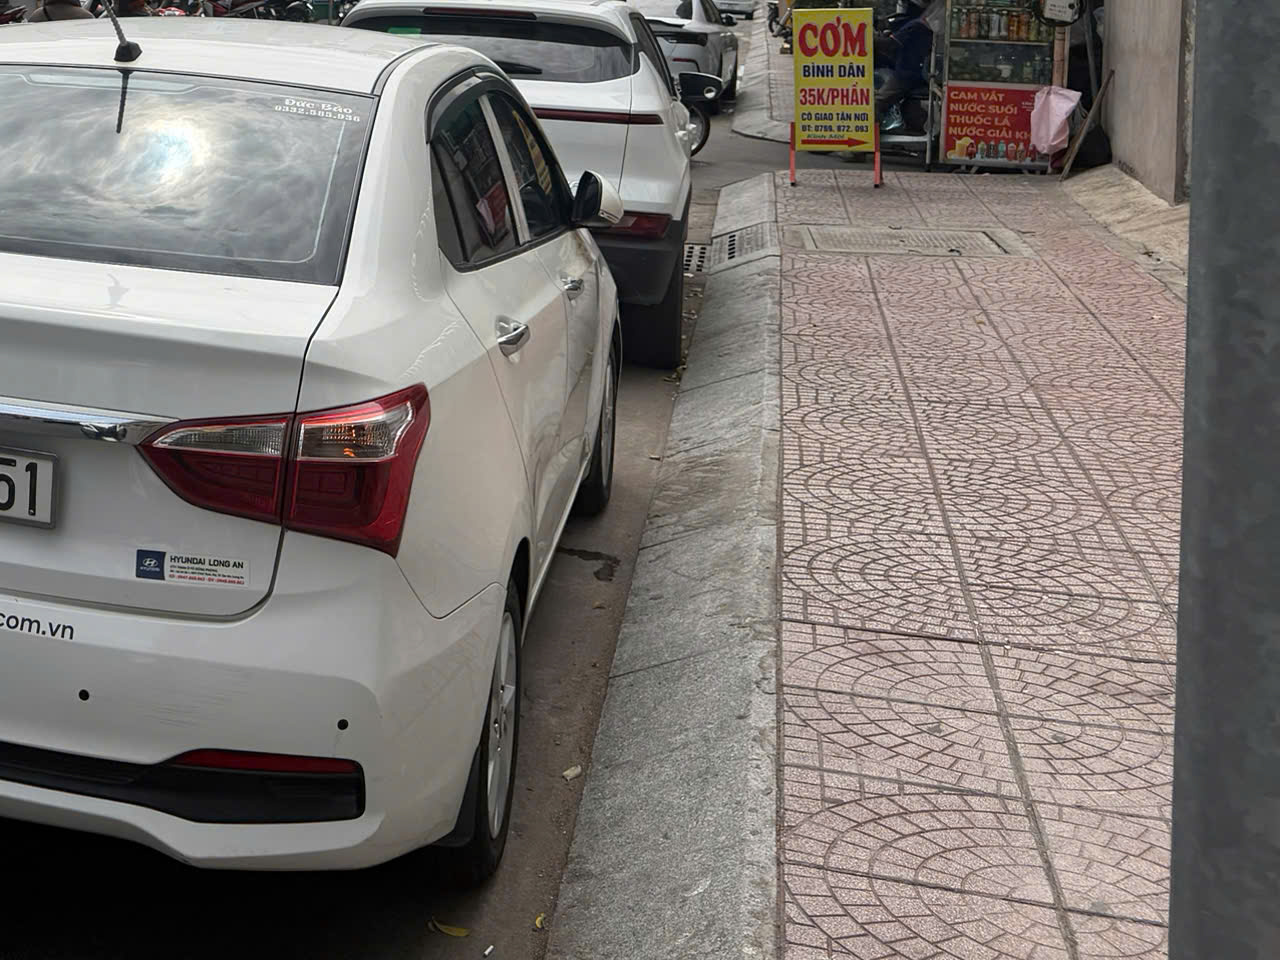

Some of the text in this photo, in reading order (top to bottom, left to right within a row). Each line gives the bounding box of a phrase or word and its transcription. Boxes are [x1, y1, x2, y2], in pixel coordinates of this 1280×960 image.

[798, 16, 868, 57] CƠM
[802, 62, 866, 78] BÌNH DÂN
[950, 91, 978, 100] CAM
[949, 102, 1018, 115] NƯỚC SUỐI
[814, 112, 833, 121] GIAO
[949, 114, 992, 126] THUỐC
[948, 126, 985, 137] NƯỚC
[170, 555, 244, 569] HYUNDAI LONG AN
